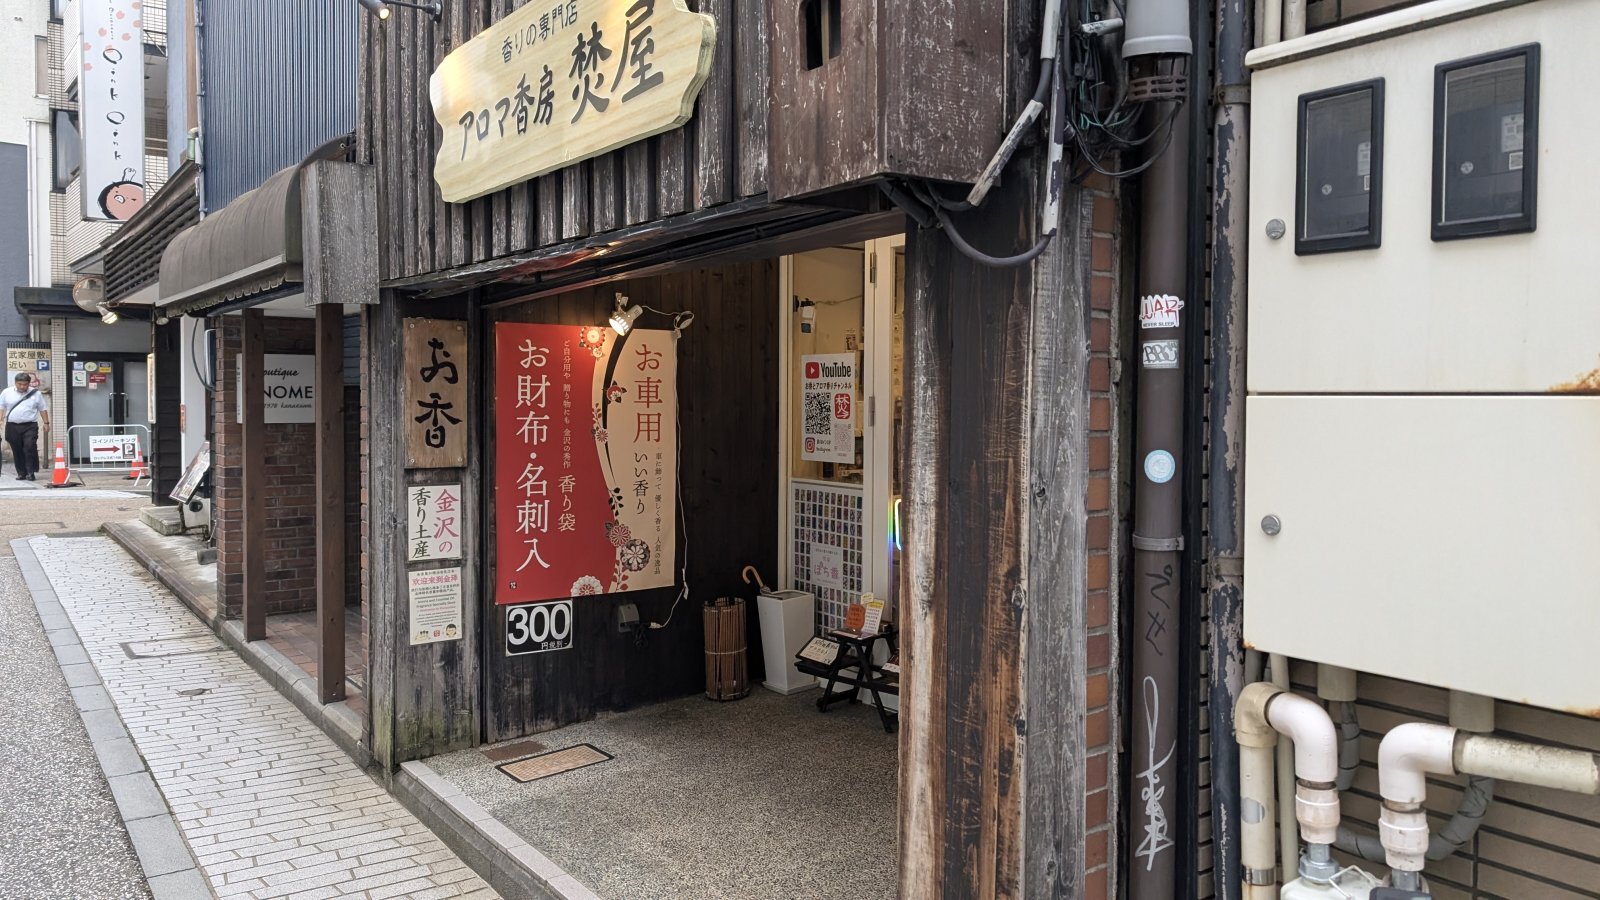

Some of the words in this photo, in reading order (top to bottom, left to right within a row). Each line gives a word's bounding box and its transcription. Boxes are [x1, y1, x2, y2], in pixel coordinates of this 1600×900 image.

[501, 0, 578, 64] 香りの専門店
[102, 48, 123, 101] Oink
[458, 64, 555, 161] アロマ香房
[568, 0, 664, 125] 焚屋
[106, 110, 125, 160] Oink
[8, 360, 27, 369] 近い
[38, 361, 48, 370] P
[264, 368, 299, 381] outique
[264, 385, 313, 399] NOME
[414, 337, 463, 449] お香
[633, 343, 663, 443] お車用
[820, 361, 852, 378] YouTube
[515, 338, 551, 572] お財布・名刺入
[633, 452, 649, 515] いい香り
[410, 487, 432, 559] 香り土産
[433, 488, 460, 553] 金沢の
[558, 474, 576, 532] 香り袋
[508, 603, 570, 645] 300
